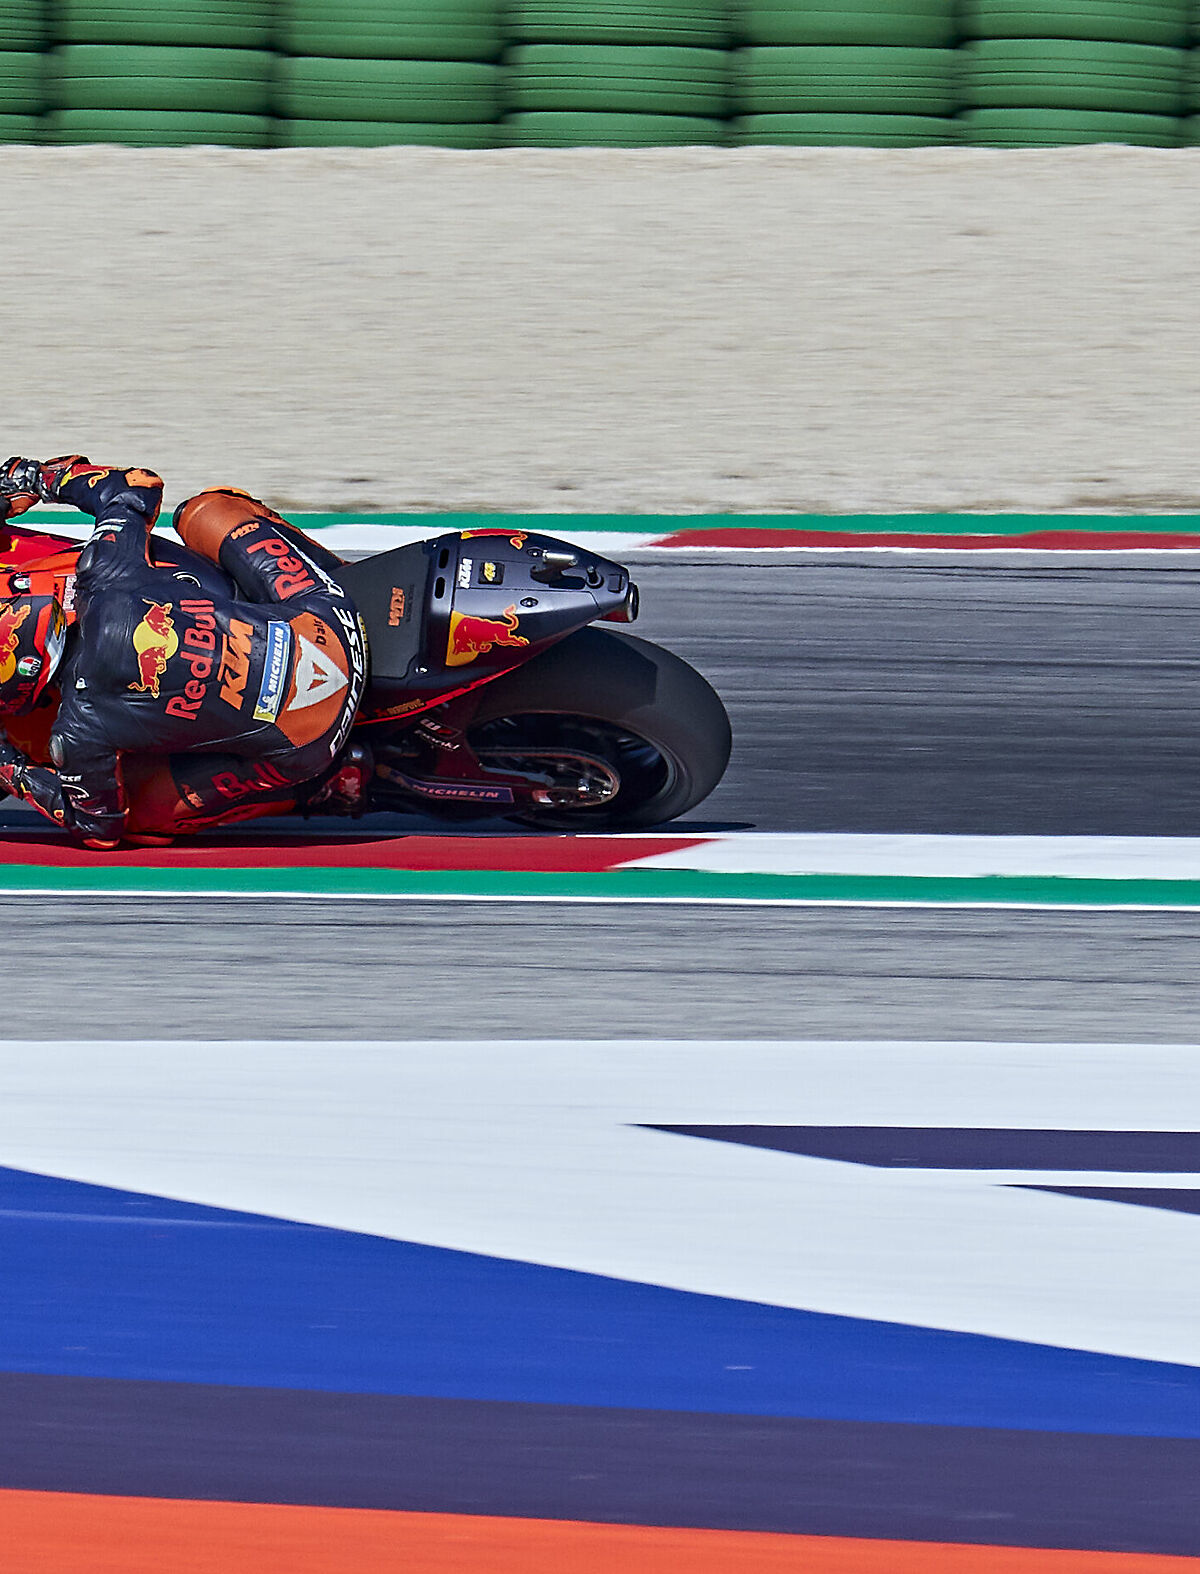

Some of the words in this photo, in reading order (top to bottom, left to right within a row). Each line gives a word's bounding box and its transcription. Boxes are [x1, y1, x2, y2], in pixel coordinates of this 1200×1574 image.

[246, 538, 315, 600] Red
[458, 558, 473, 589] KTM
[388, 587, 405, 626] KTM
[217, 618, 253, 710] KTM
[268, 627, 284, 693] MICHELIN
[211, 761, 291, 799] Bull
[412, 784, 499, 798] MICHELIN
